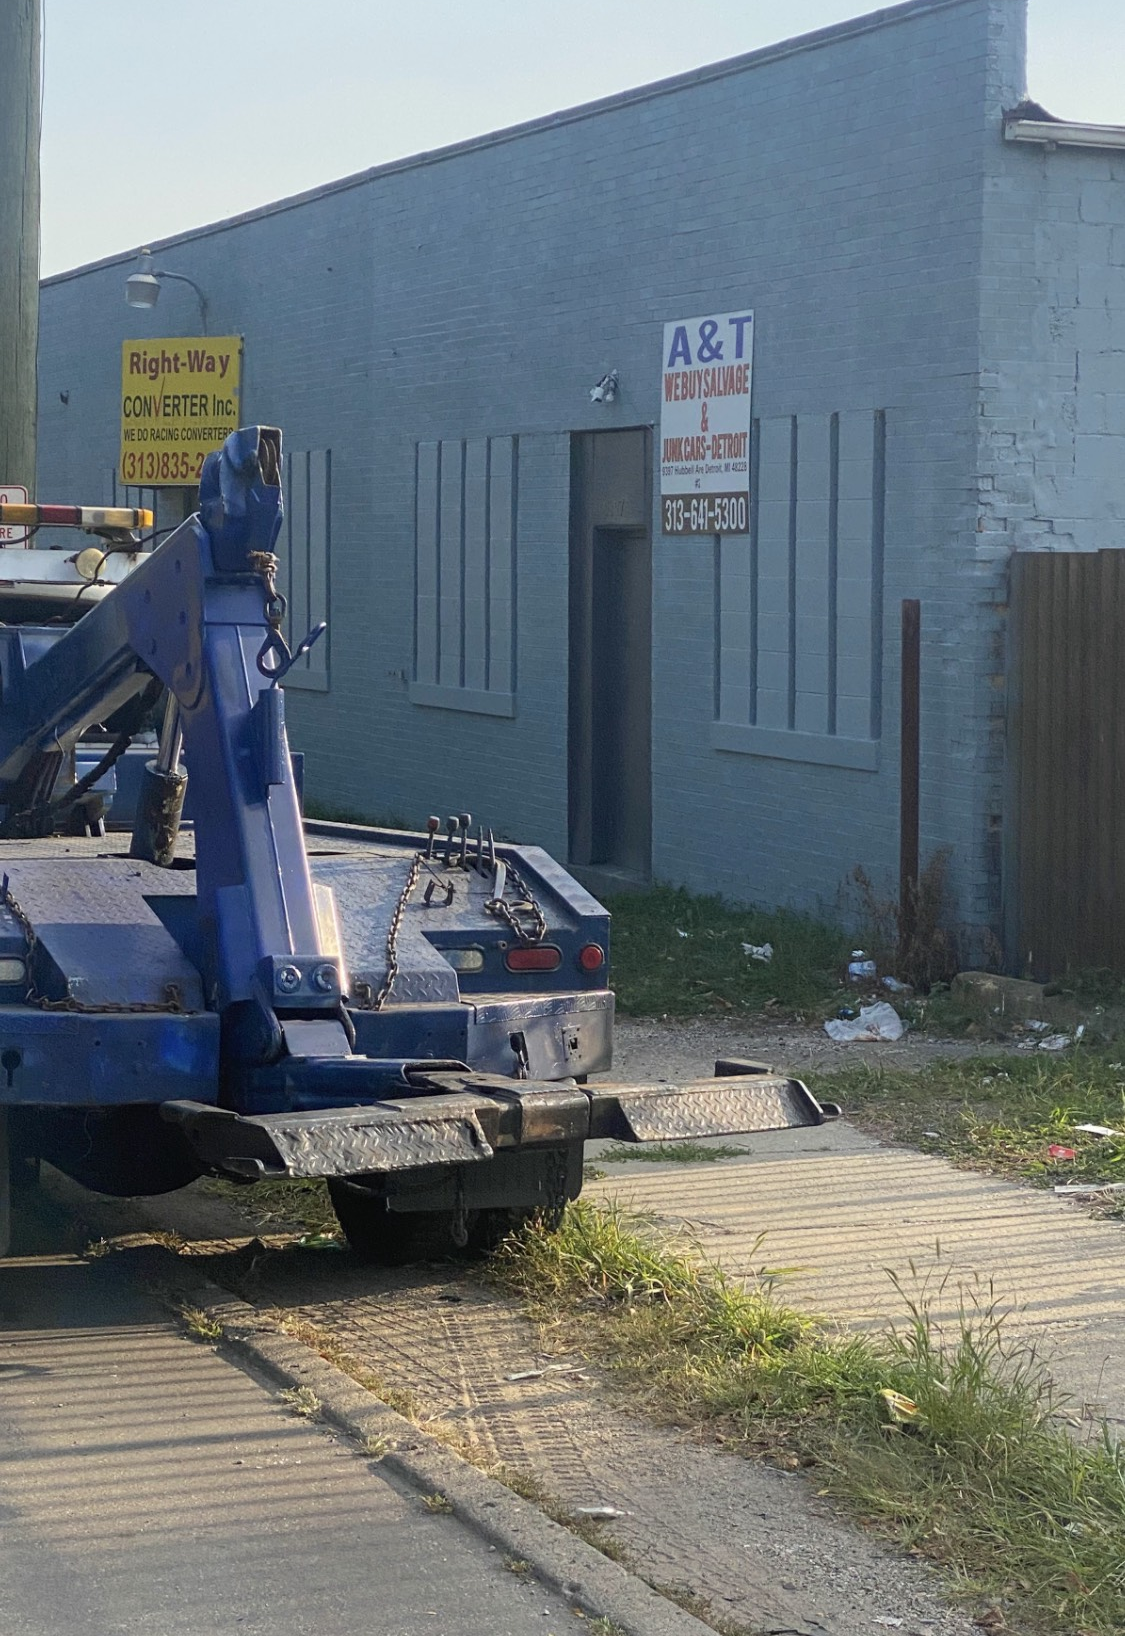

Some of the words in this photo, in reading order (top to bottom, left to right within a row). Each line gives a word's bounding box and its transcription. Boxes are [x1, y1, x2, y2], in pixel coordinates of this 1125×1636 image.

[129, 349, 230, 380] Right-Way
[665, 371, 681, 402] WE
[681, 369, 703, 400] BUY
[703, 363, 750, 398] SALVAGE
[123, 394, 208, 418] CONVERTER
[212, 393, 236, 417] Inc.
[700, 401, 709, 432] &
[124, 429, 135, 441] WE
[137, 428, 149, 441] DO
[150, 427, 179, 441] RACING
[662, 436, 684, 463] JUNK
[122, 451, 205, 480] (313)835-2
[665, 497, 746, 531] 313-641-5300
